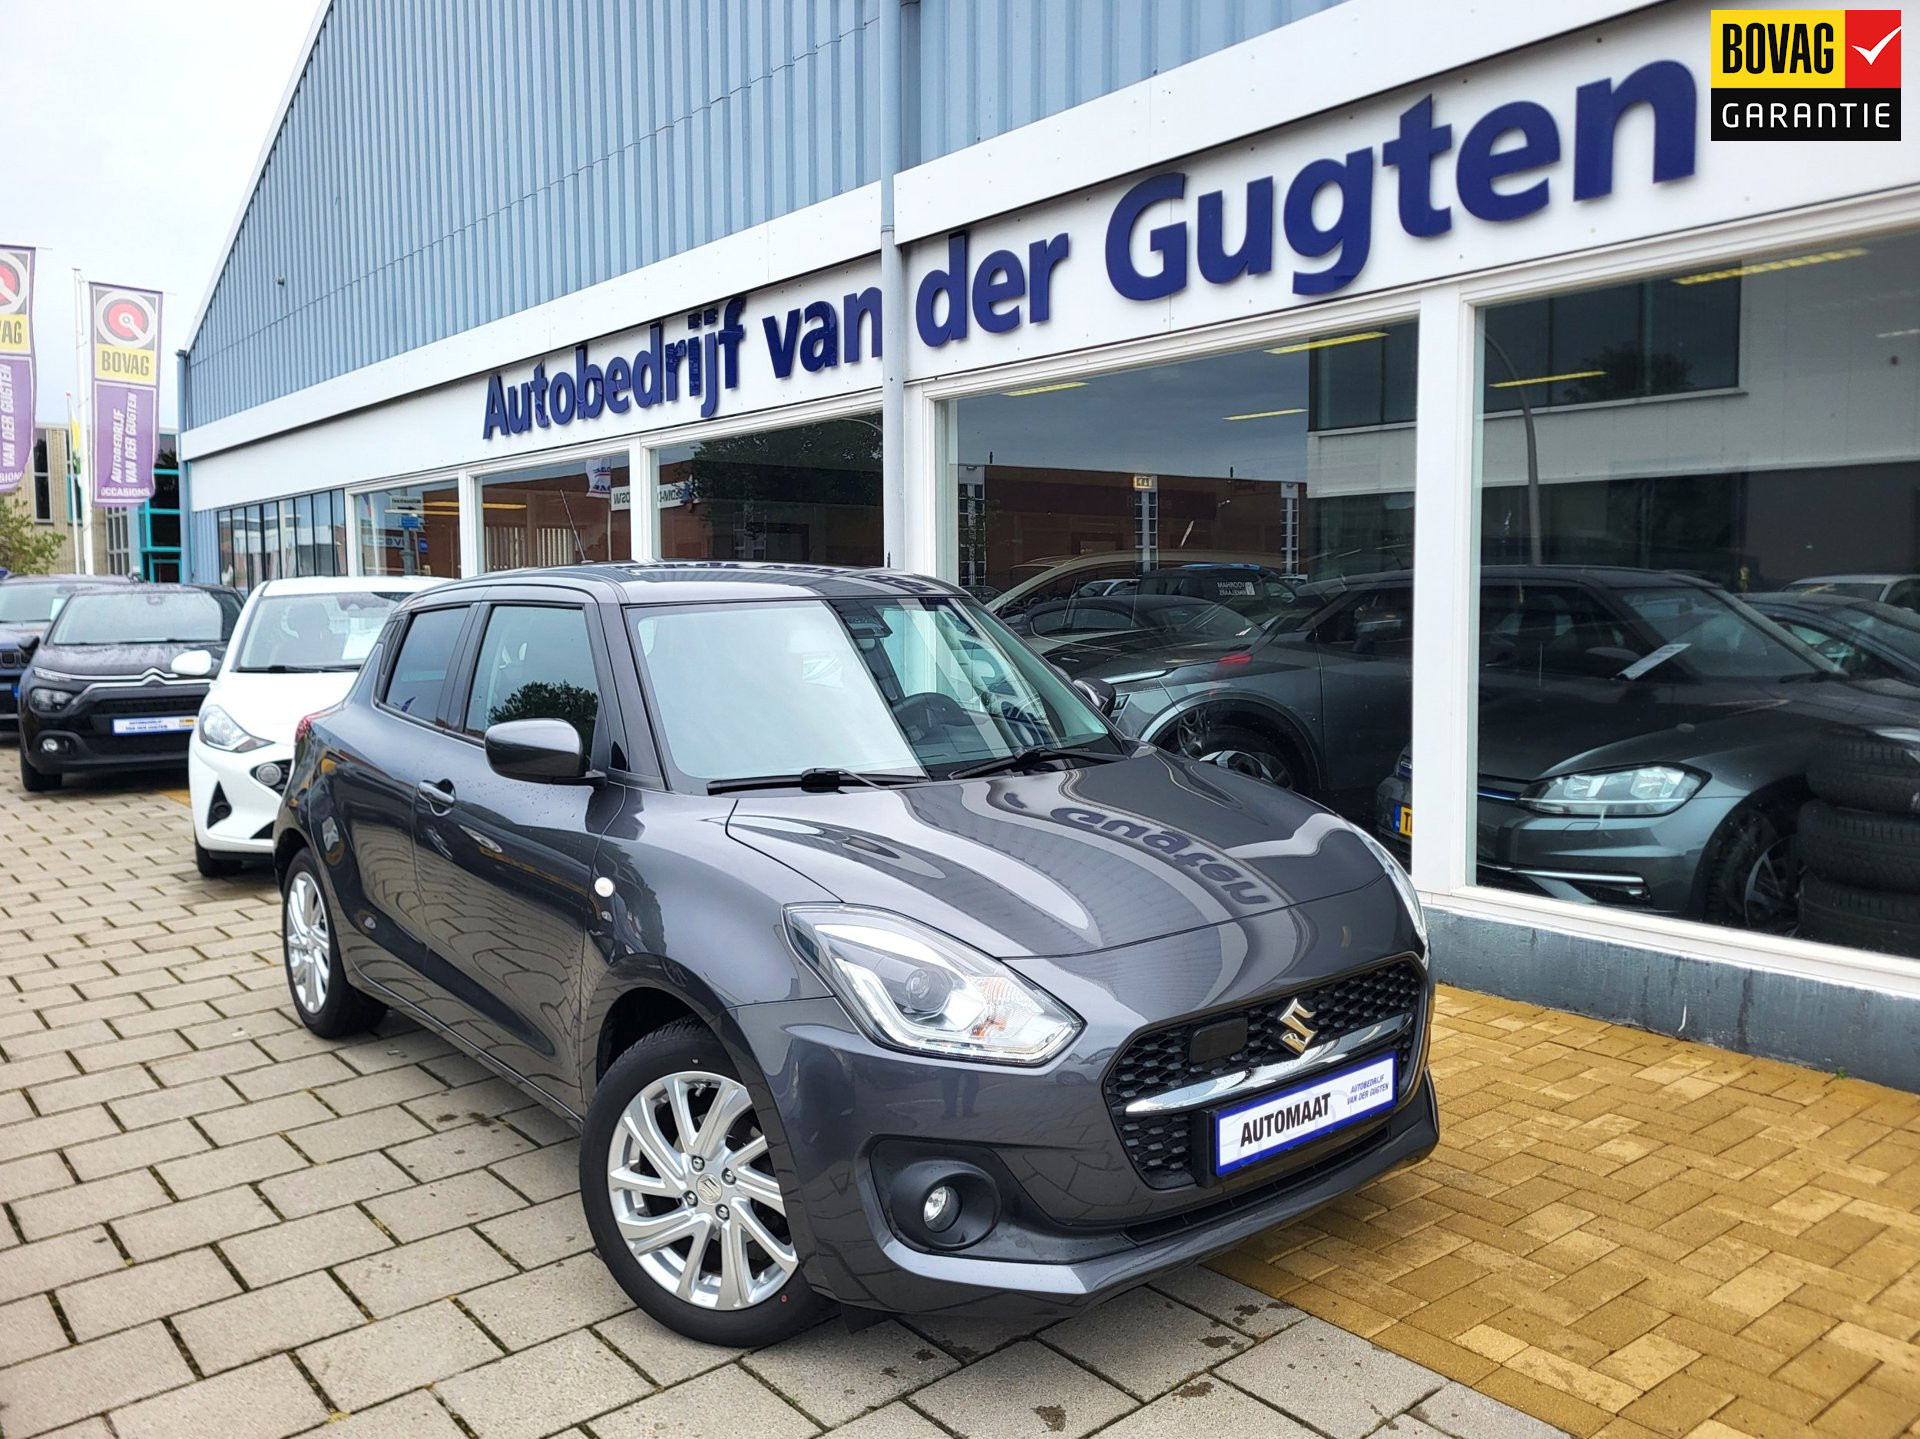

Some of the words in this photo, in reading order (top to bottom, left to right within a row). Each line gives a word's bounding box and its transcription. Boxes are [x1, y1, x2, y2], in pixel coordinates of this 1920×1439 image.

[482, 294, 747, 441] Autobedrijf
[762, 287, 883, 379] van
[914, 230, 1070, 348] der
[1105, 59, 1698, 303] Gugten
[0, 320, 22, 345] AG
[101, 350, 150, 376] BOVAG
[125, 392, 137, 436] GUGTEN
[1, 415, 15, 441] DER
[2, 442, 15, 467] VAN
[125, 438, 137, 460] DER
[125, 460, 137, 483] VAN
[101, 487, 150, 497] OCCASIONS
[1347, 1095, 1358, 1105] VAN
[1358, 1090, 1369, 1101] DER
[1370, 1082, 1389, 1096] GUGTEN
[1350, 1074, 1384, 1094] AUTOBEDRIJF
[1240, 1093, 1331, 1147] AUTOMAAT
